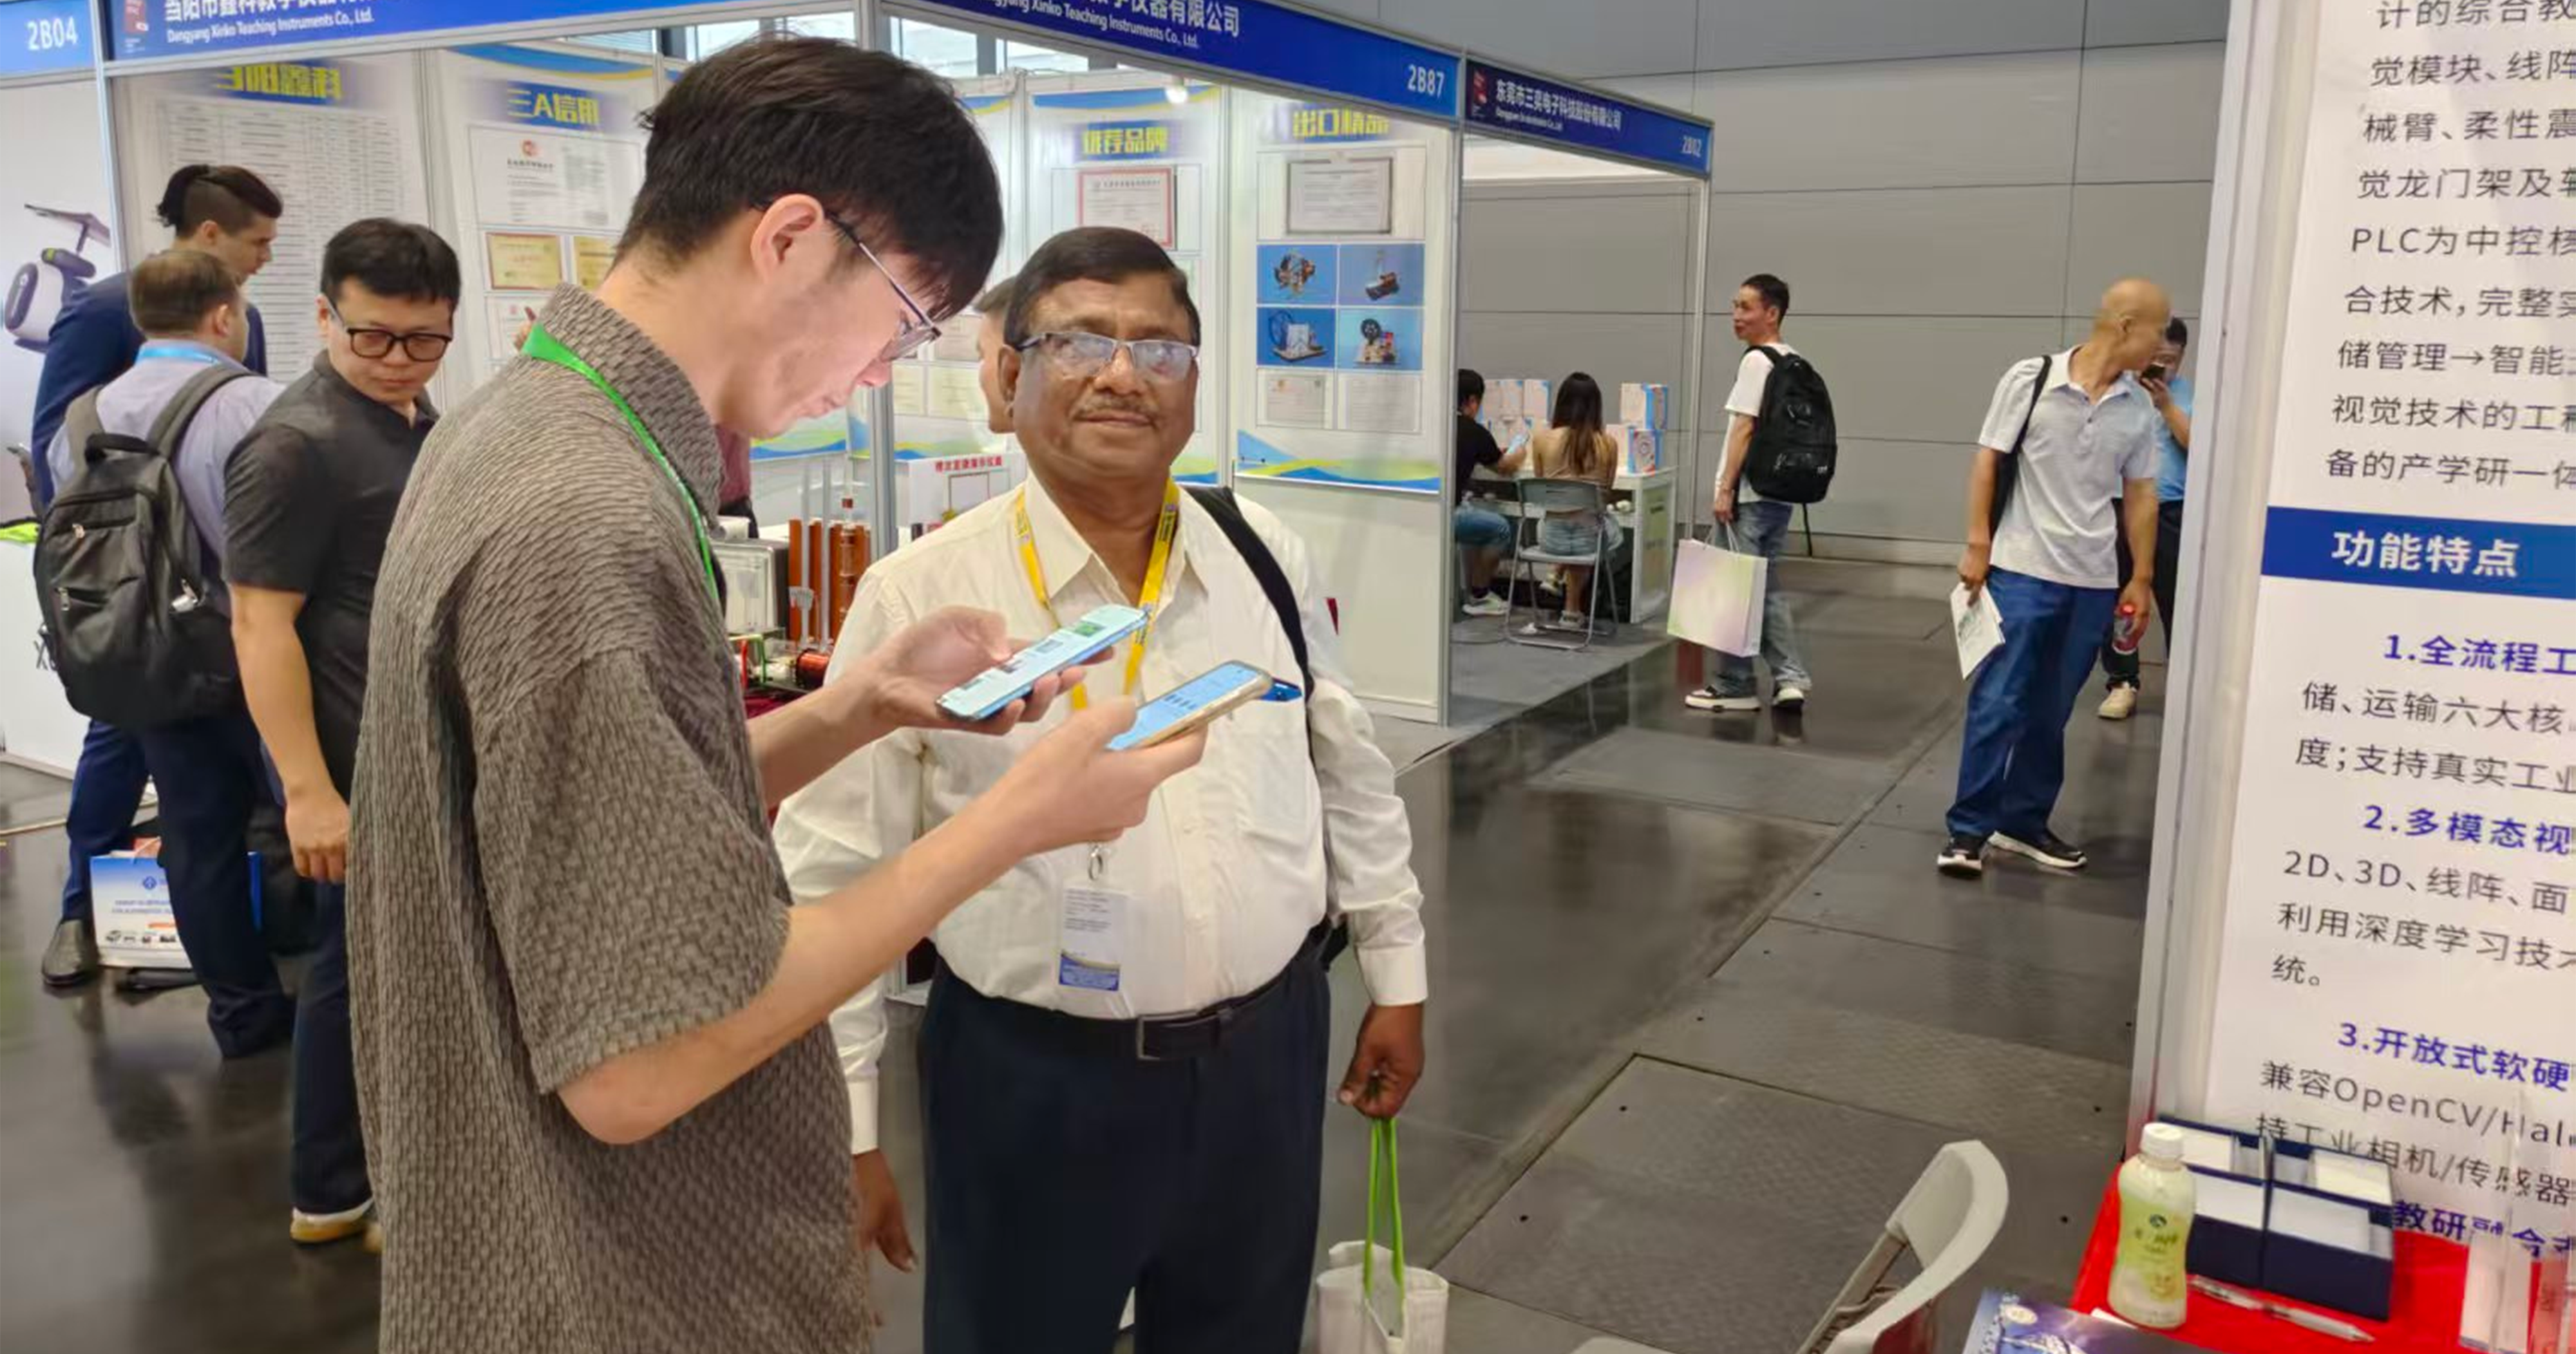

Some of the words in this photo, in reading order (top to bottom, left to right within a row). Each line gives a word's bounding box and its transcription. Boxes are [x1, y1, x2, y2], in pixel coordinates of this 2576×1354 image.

[27, 16, 78, 50] 2B04
[236, 19, 277, 36] Teaching
[277, 14, 334, 32] Instruments
[1064, 3, 1107, 31] Teaching
[1109, 14, 1164, 41] Instruments
[1407, 64, 1445, 99] 2B87
[2371, 50, 2576, 87] 觉模块、线阵
[507, 88, 600, 125] 三A信用
[2363, 108, 2576, 144] 械臂、柔性震
[2351, 225, 2576, 256] PLC为中控核
[2338, 339, 2576, 376] 储管理→智能
[2325, 449, 2576, 490] 备的产学研一体
[2331, 529, 2521, 578] 功能特点
[2383, 634, 2576, 676] 1.全流程工
[2302, 681, 2576, 735] 储、运输六大核
[2284, 850, 2570, 915] 2D、3D、线阵、面
[2271, 953, 2320, 987] 统。
